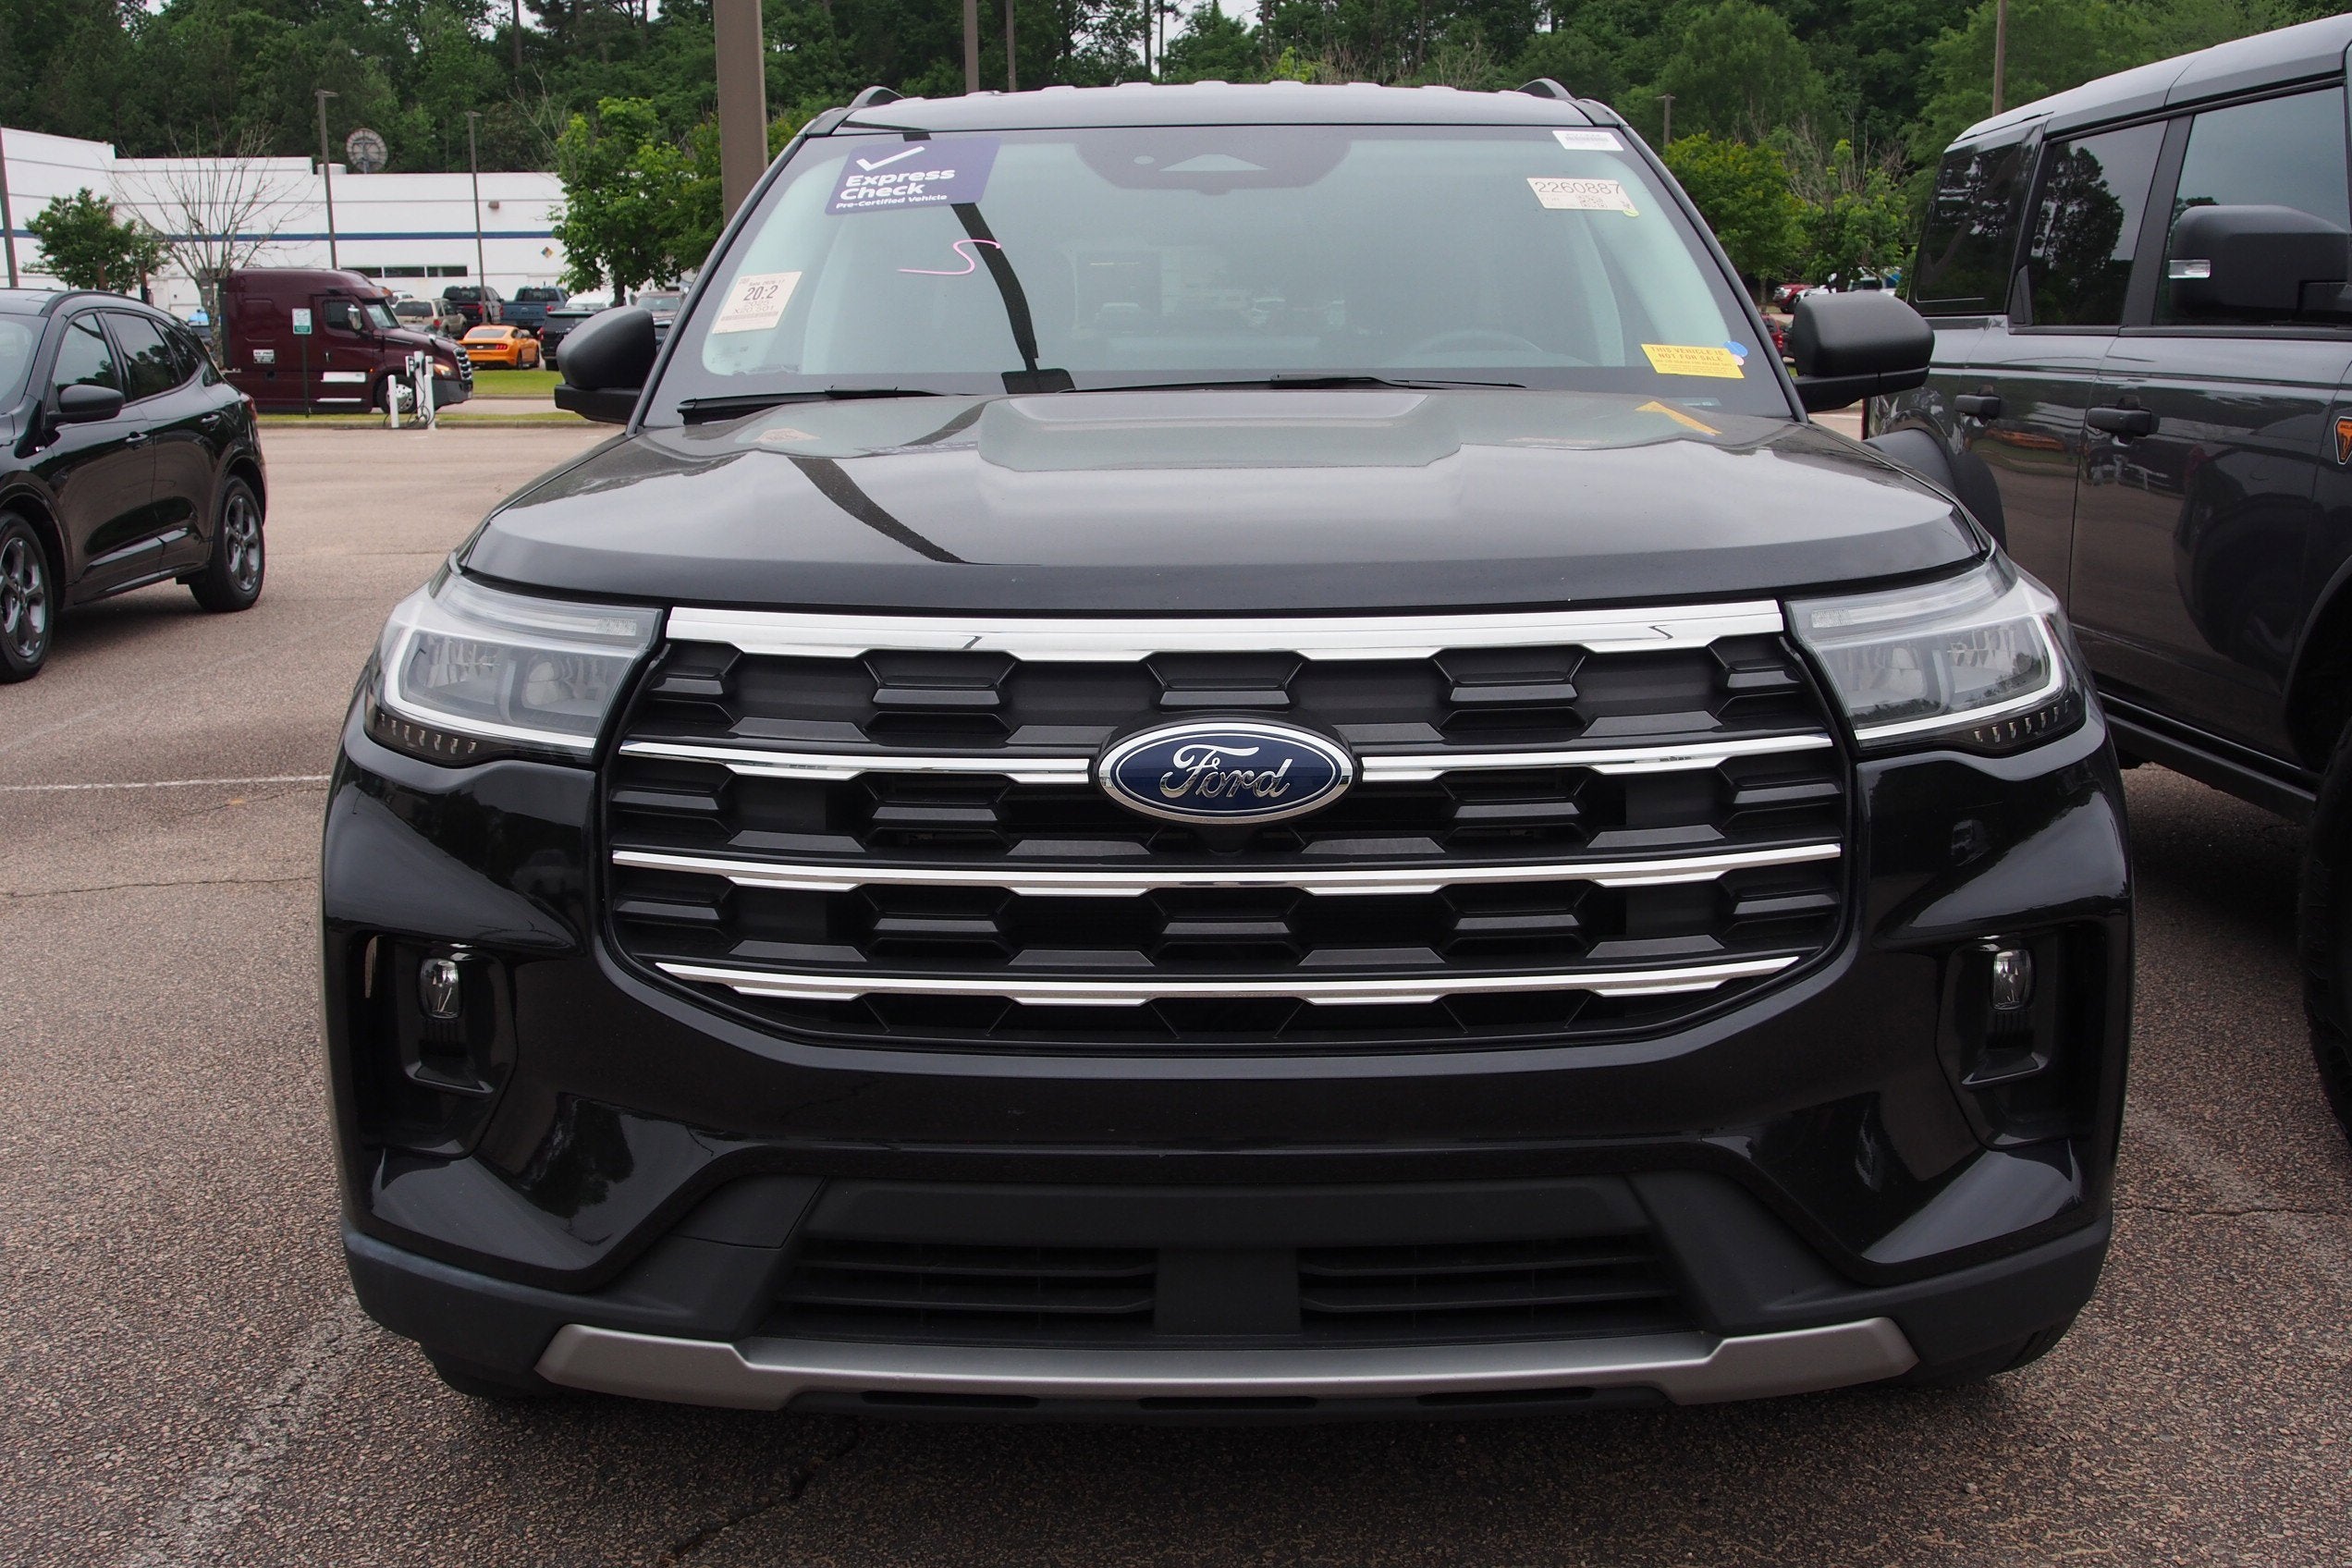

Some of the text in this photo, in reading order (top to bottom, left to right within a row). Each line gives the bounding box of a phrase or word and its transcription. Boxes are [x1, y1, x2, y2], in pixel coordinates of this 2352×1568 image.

[845, 169, 956, 187] Express
[839, 182, 925, 201] Check
[1535, 181, 1620, 195] 2260887
[836, 194, 948, 209] Pre-Certified Vehicle
[1674, 347, 1712, 356] VEHICLE
[1159, 743, 1293, 799] Ford
